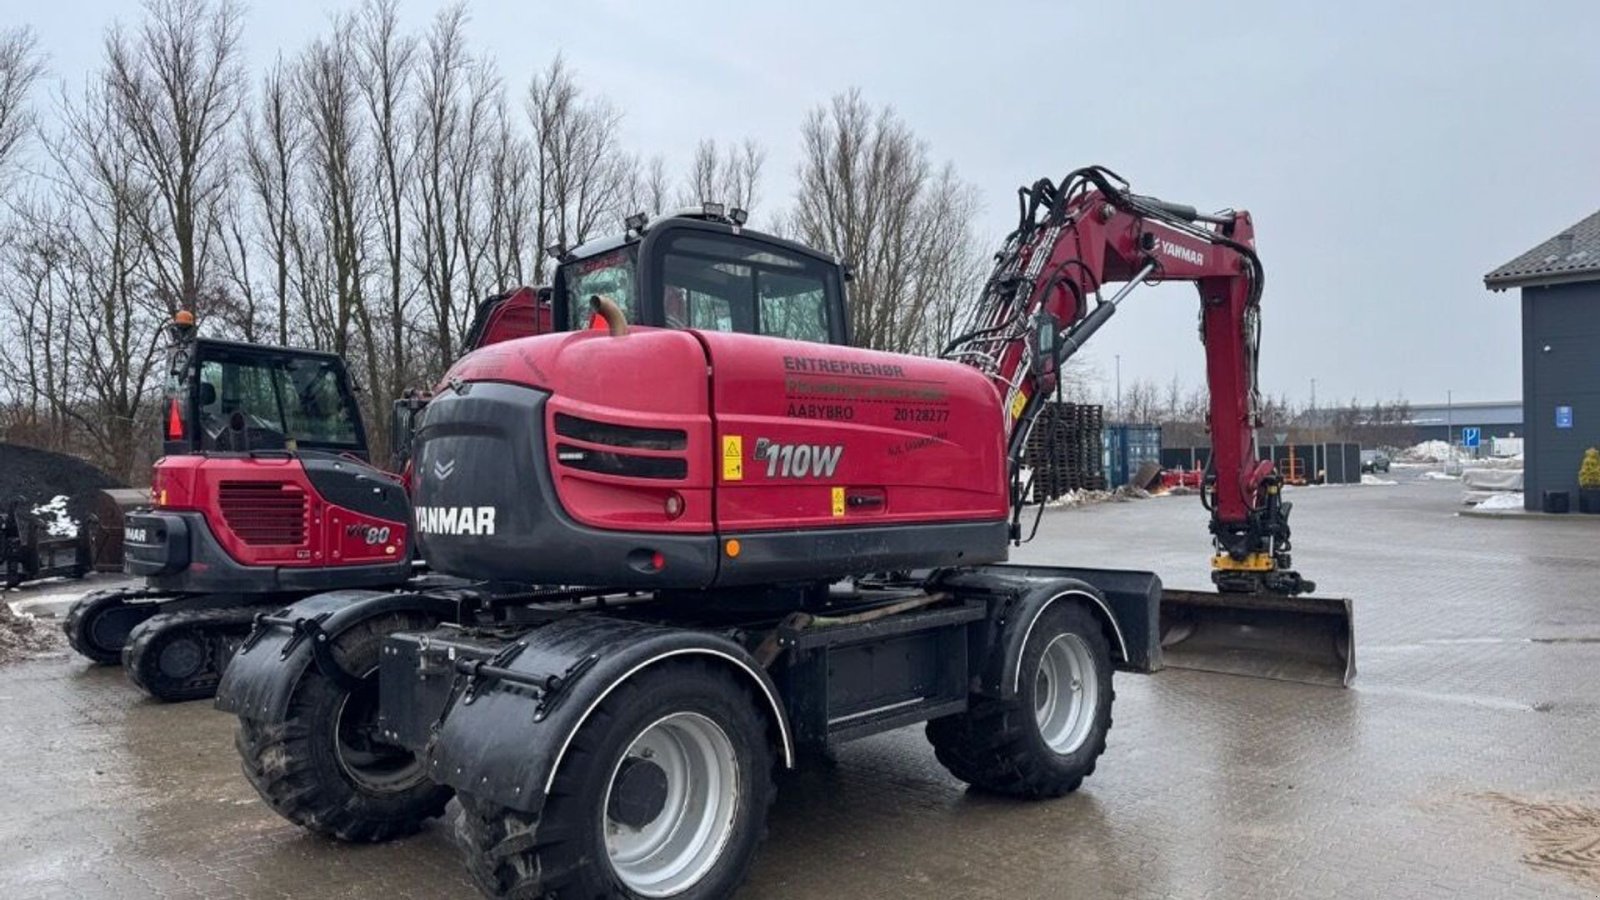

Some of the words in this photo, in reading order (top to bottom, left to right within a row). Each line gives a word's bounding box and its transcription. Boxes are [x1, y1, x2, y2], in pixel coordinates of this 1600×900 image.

[1161, 240, 1204, 266] YANMAR
[784, 356, 904, 376] ENTREPRENØR
[787, 403, 854, 420] AABYBRO
[414, 505, 496, 535] YANMAR
